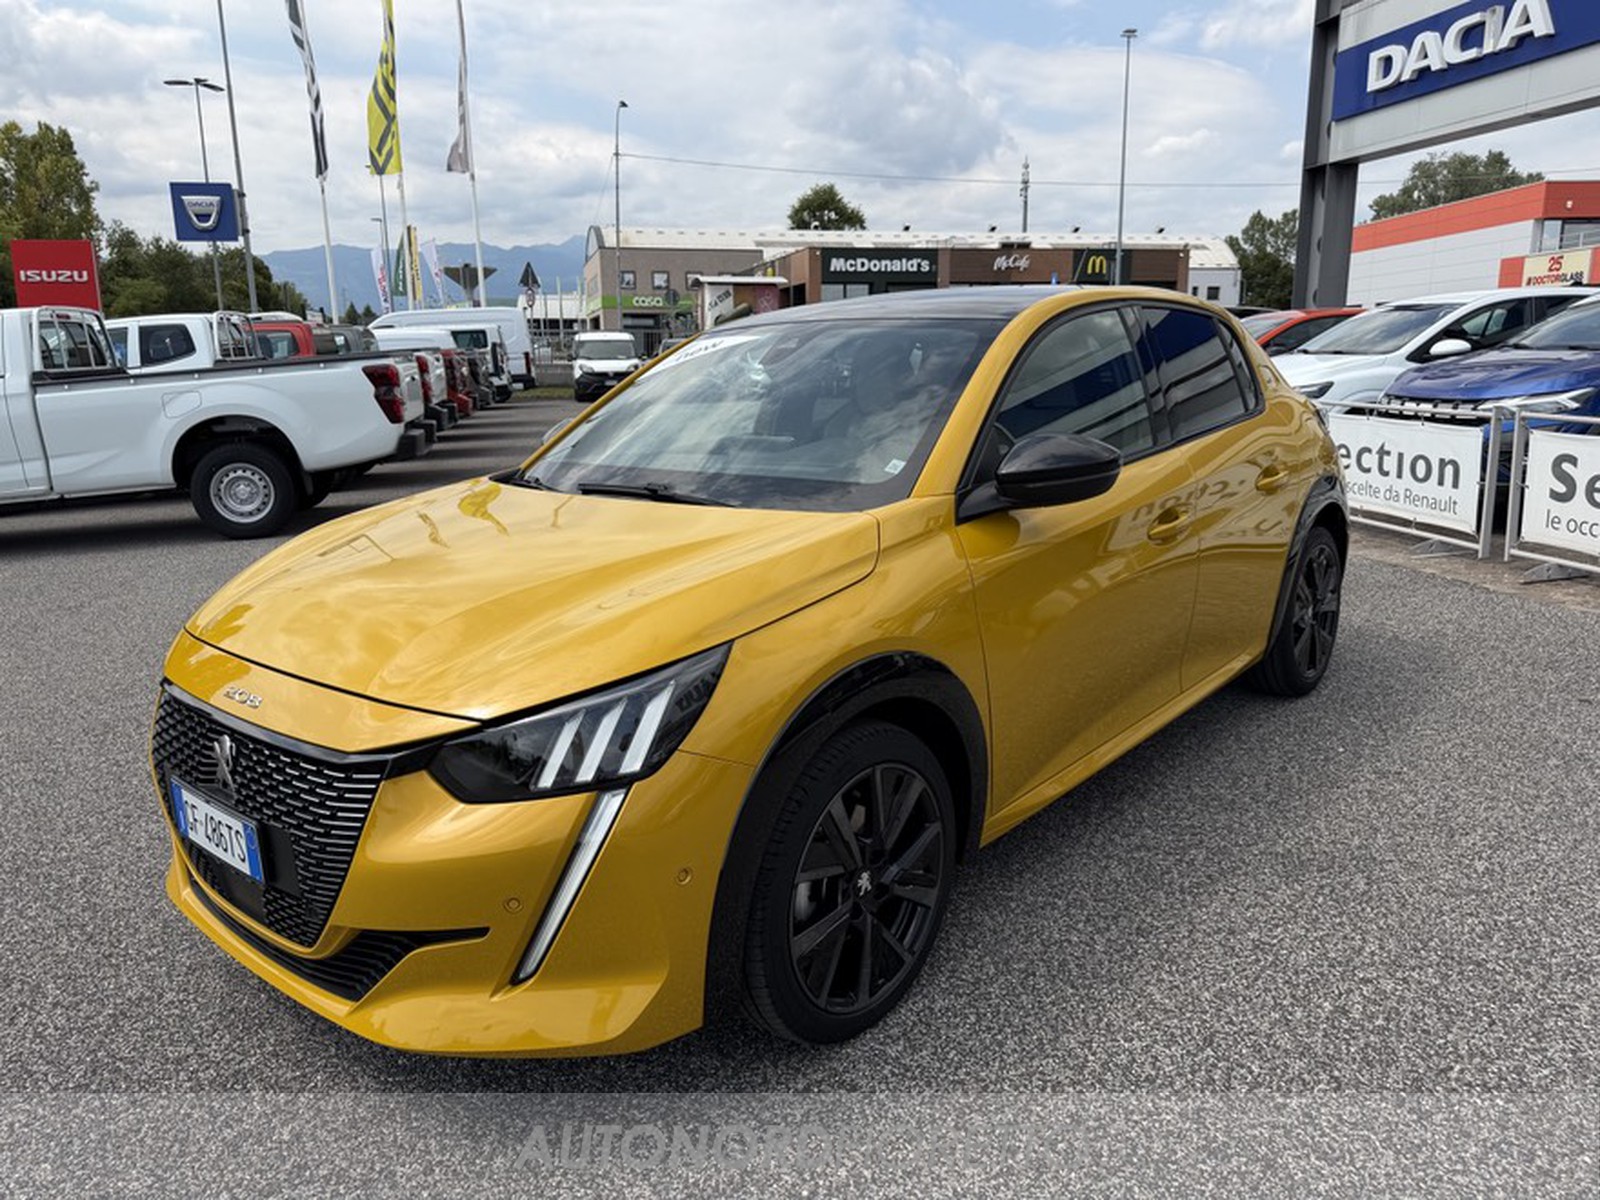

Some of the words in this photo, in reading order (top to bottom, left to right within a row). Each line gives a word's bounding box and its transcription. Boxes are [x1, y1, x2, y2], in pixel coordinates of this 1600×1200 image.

[1366, 0, 1556, 94] DACIA
[187, 200, 215, 208] DACIA
[829, 257, 931, 273] McDonald's
[1547, 255, 1565, 273] 25
[19, 269, 89, 283] ISUZU
[632, 296, 663, 307] casa
[1337, 441, 1460, 490] ection
[1548, 453, 1600, 510] Se
[1383, 484, 1402, 504] da
[1403, 488, 1459, 515] Renault
[1545, 509, 1561, 531] le
[1566, 517, 1600, 538] occ
[224, 688, 262, 708] 208
